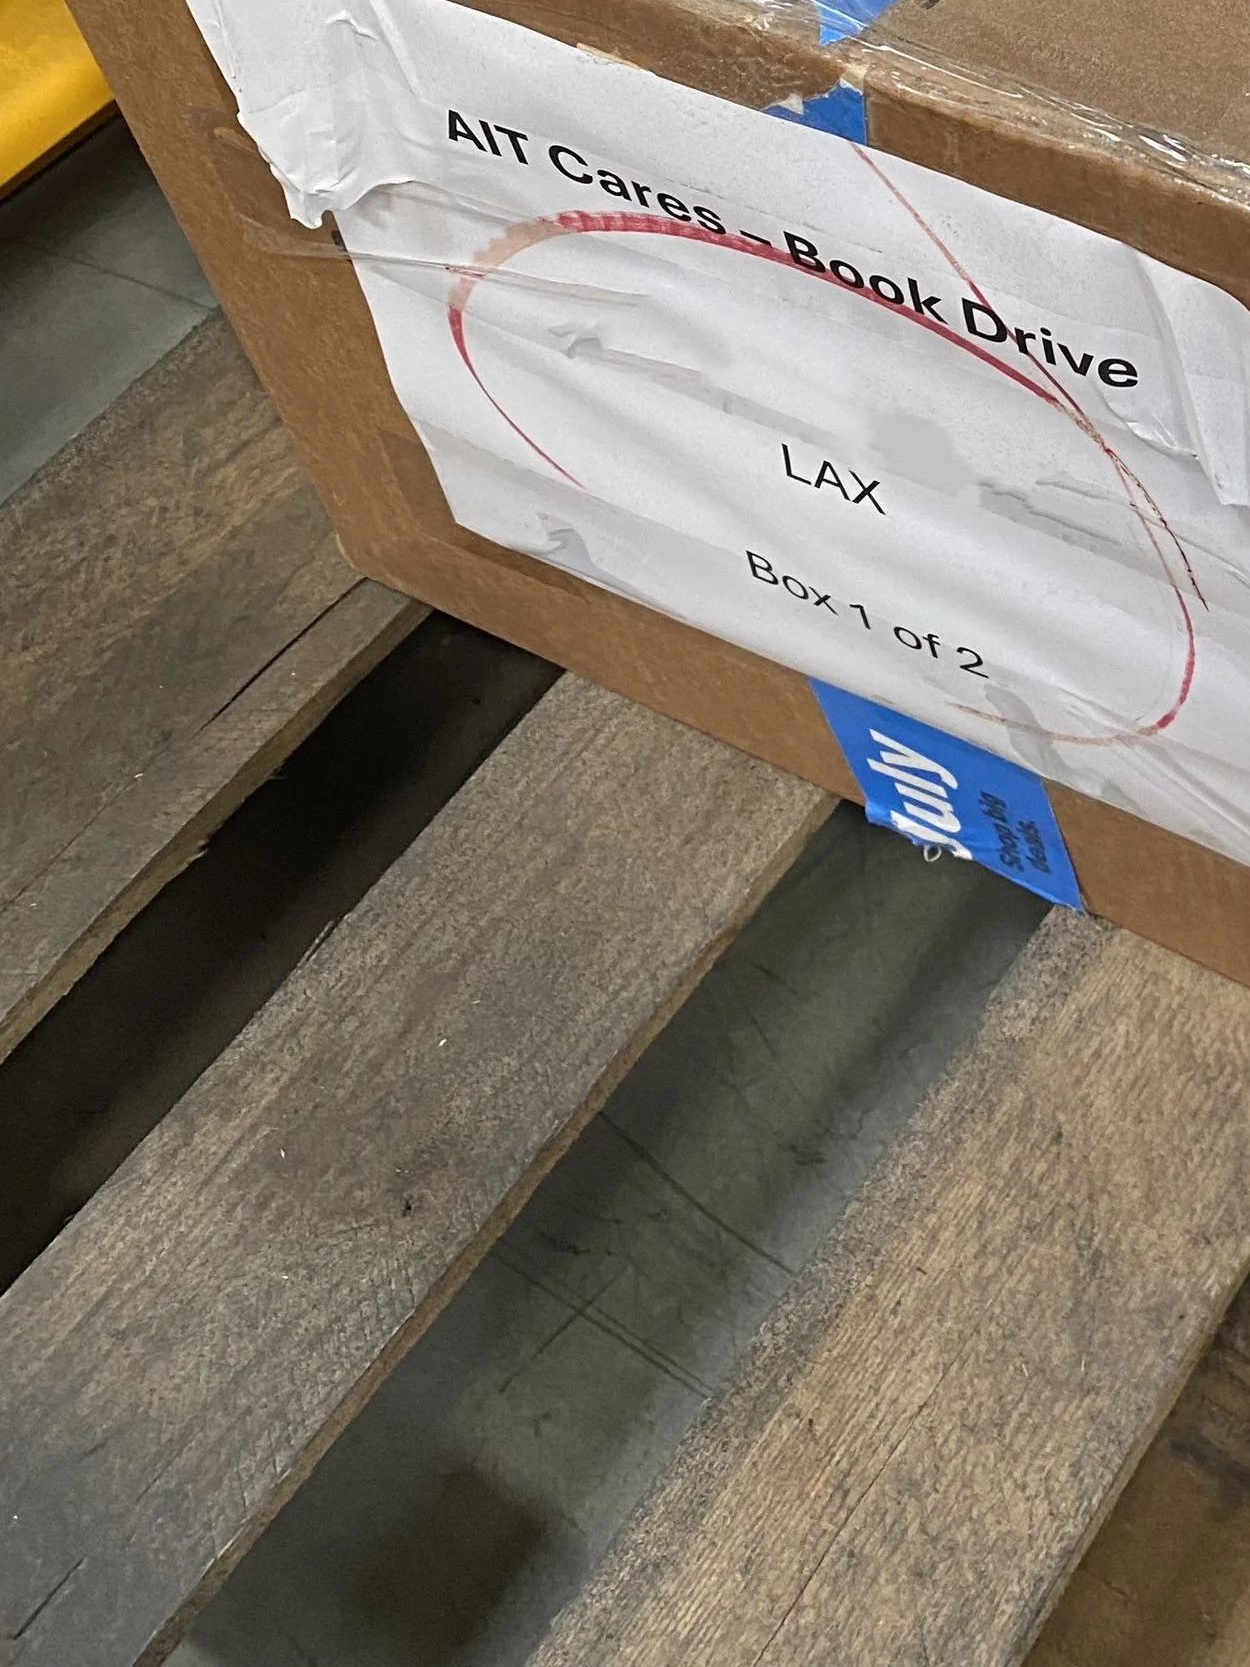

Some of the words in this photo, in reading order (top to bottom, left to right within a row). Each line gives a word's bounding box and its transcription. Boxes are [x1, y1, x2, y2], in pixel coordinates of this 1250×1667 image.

[446, 109, 529, 168] AIT
[547, 141, 724, 239] Cares
[784, 231, 947, 325] Book
[962, 297, 1140, 390] Drive
[781, 444, 887, 515] LAX
[745, 549, 834, 617] Box
[850, 602, 873, 631] 1
[893, 621, 945, 662] of
[955, 643, 991, 679] 2
[866, 728, 973, 861] July
